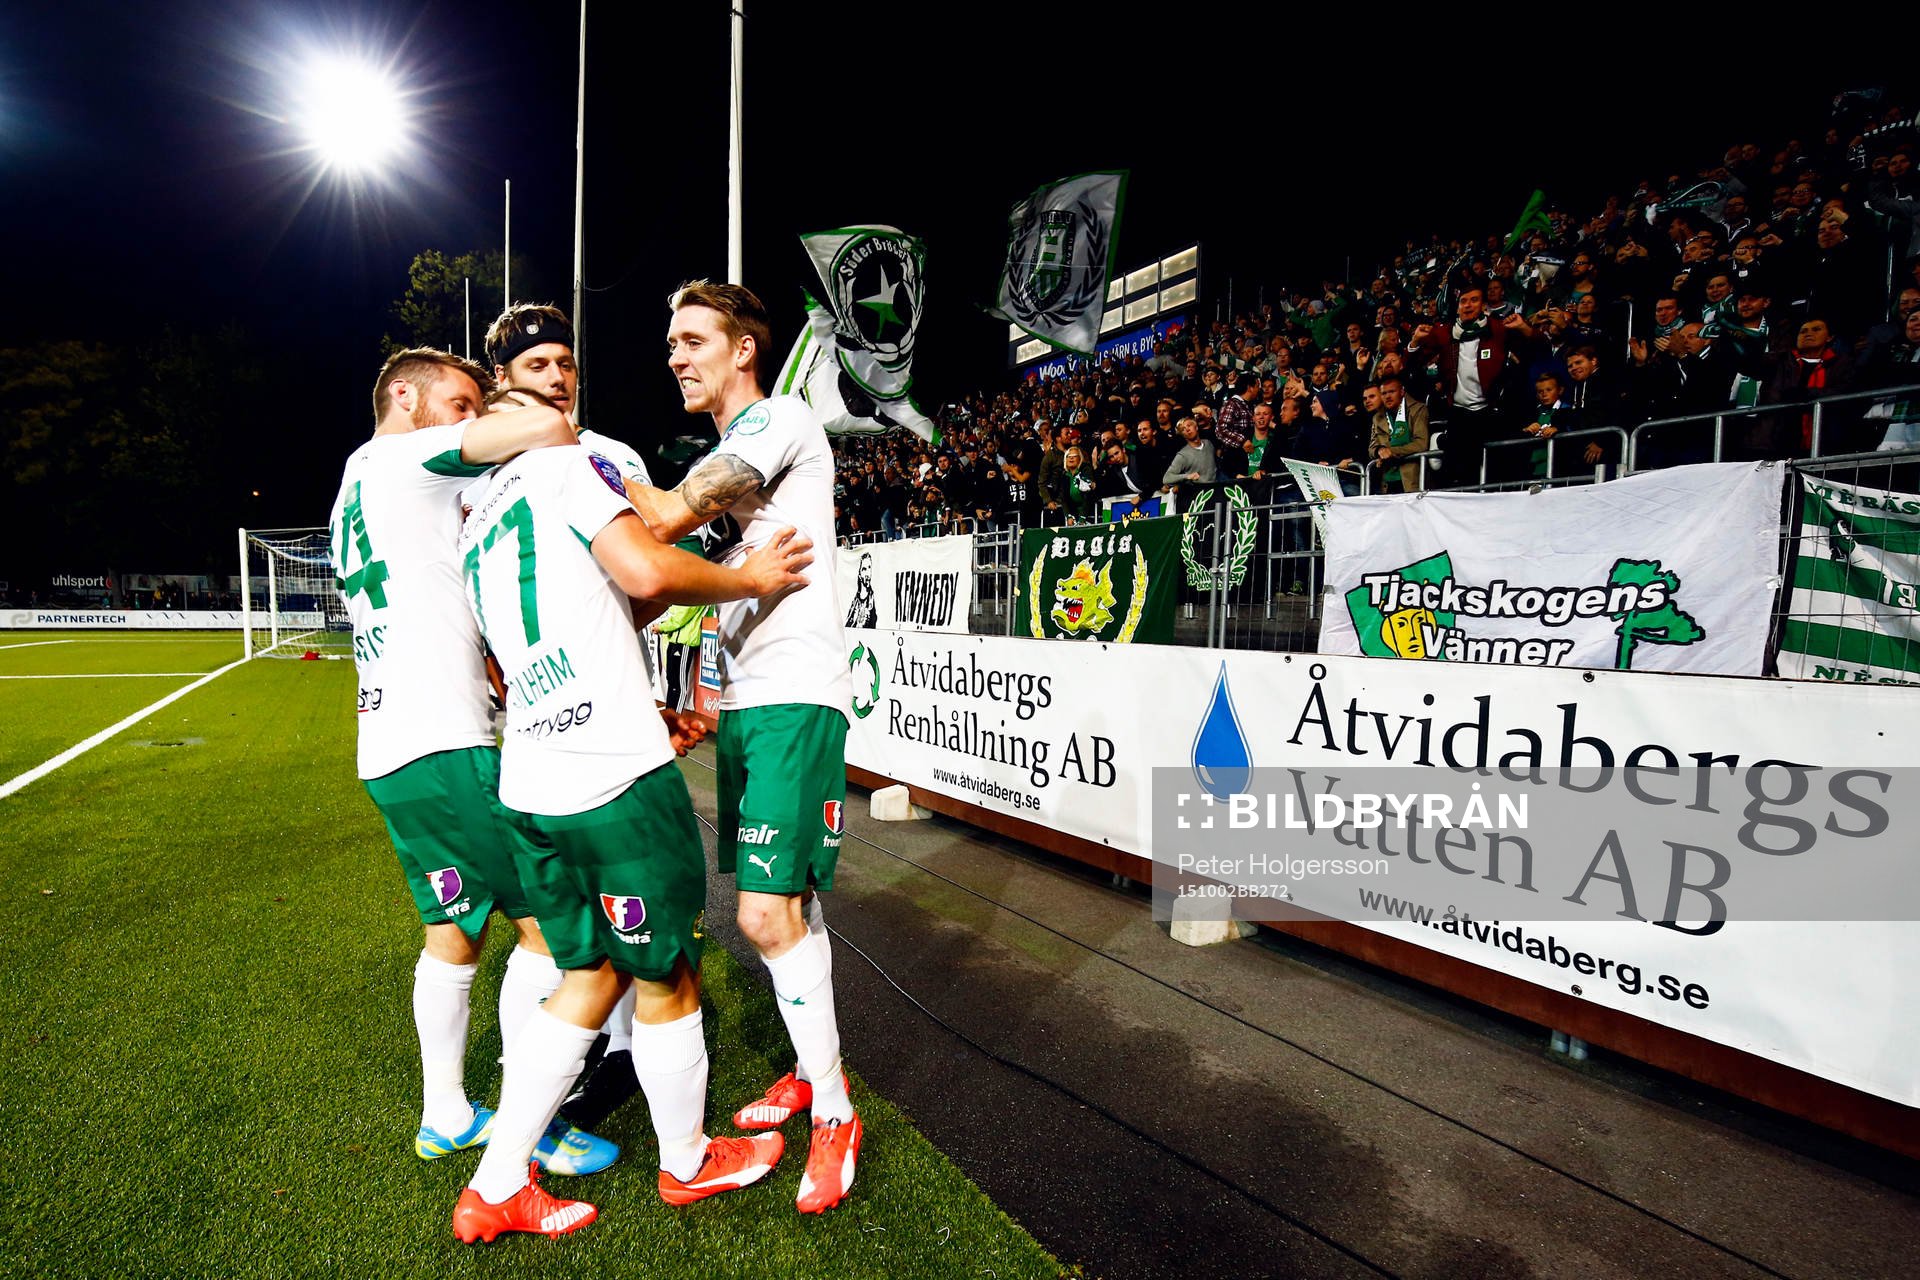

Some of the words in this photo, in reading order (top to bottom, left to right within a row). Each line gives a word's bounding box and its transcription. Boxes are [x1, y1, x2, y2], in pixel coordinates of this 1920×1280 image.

[840, 242, 873, 277] Söder
[1010, 490, 1026, 502] 78
[1051, 534, 1132, 559] Bagis
[53, 574, 104, 588] uhlsport
[896, 570, 959, 626] KENNEDY
[1362, 570, 1667, 626] Tjackskogens
[37, 614, 126, 624] PARTNERTECH
[328, 613, 353, 623] uhls
[1421, 622, 1574, 666] Vänner
[891, 636, 1052, 720] Åtvidabergs
[1812, 664, 1848, 683] NI
[888, 698, 1051, 788] Renhållning
[1058, 731, 1117, 788] AB
[1286, 663, 1894, 857] Åtvidabergs
[932, 766, 1041, 811] www.åtvidaberg.se
[1287, 767, 1540, 894] Vatten
[1563, 829, 1733, 938] AB
[1358, 883, 1711, 1011] www.åtvidaberg.se
